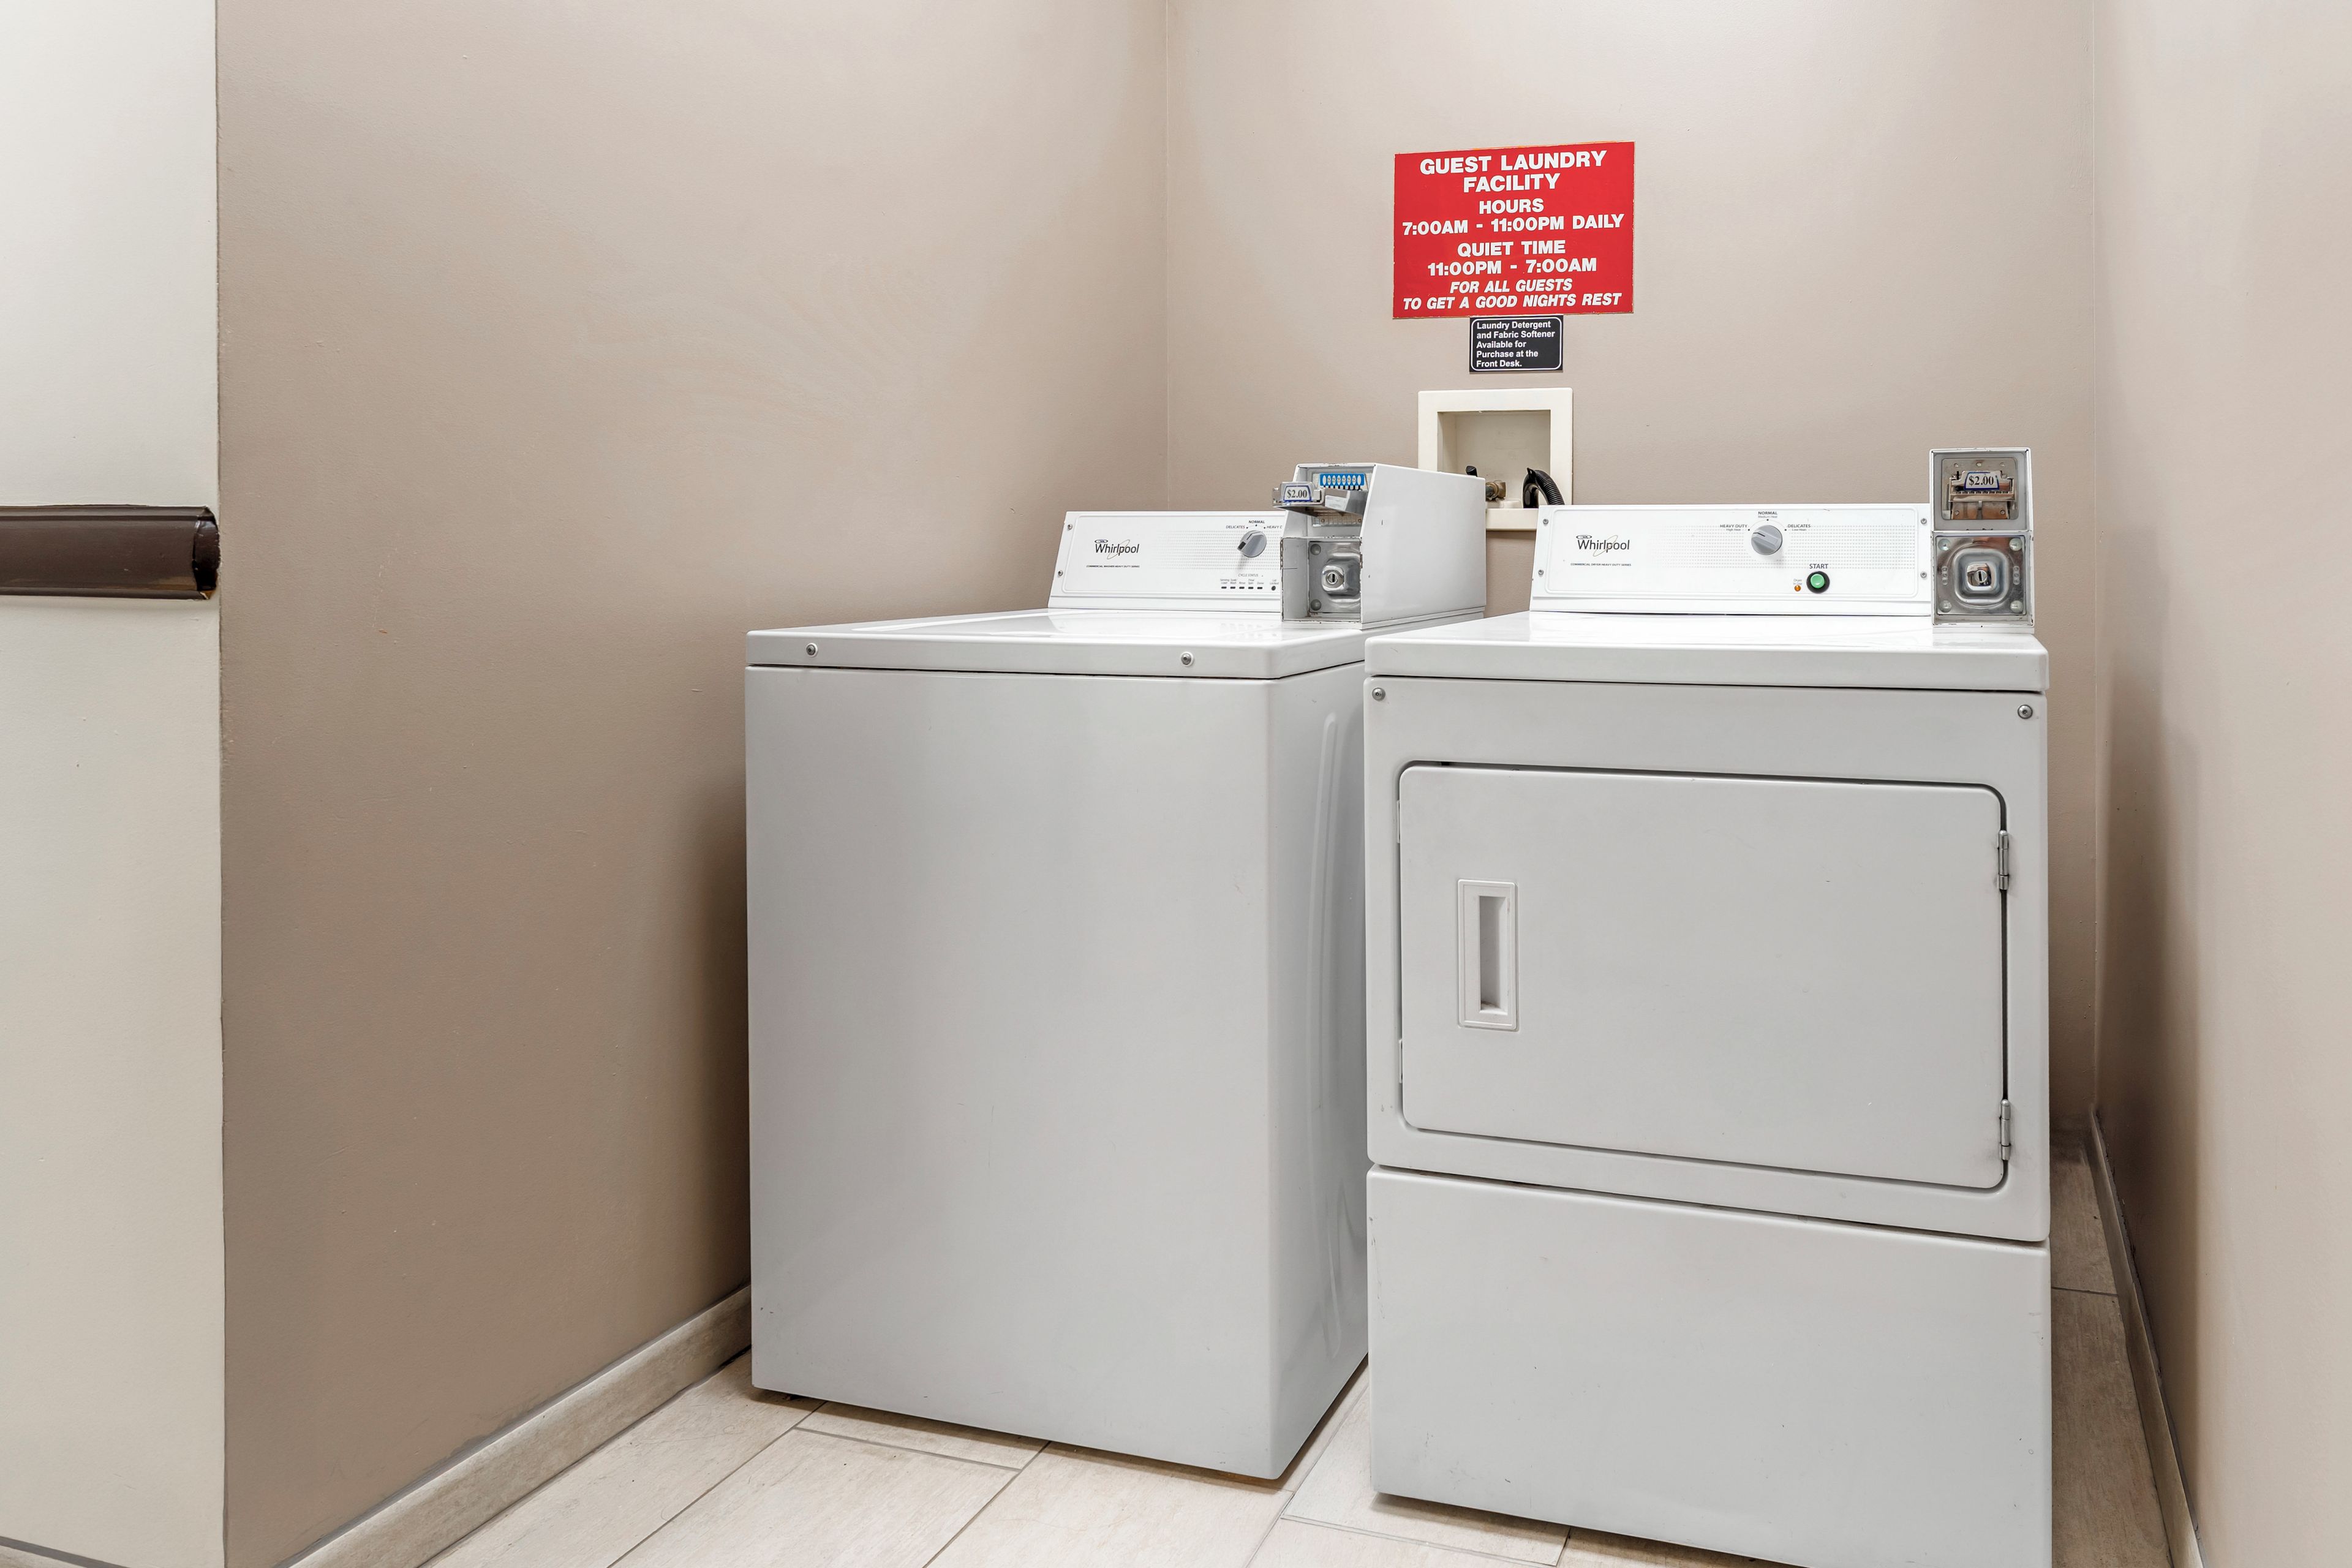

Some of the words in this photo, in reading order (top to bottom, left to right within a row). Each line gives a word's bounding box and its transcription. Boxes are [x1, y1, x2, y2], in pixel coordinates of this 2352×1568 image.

[1420, 156, 1492, 175] GUEST
[1501, 150, 1607, 171] LAUNDRY
[1463, 173, 1561, 193] FACILITY
[1479, 198, 1544, 214] HOURS
[1402, 219, 1468, 236] 7:00AM
[1491, 216, 1564, 232] 11:00PM
[1572, 214, 1625, 230] DAILY
[1457, 241, 1514, 258] QUIET
[1521, 239, 1566, 255] TIME
[1427, 260, 1502, 276] 11:00PM
[1526, 257, 1597, 273] 7:00AM
[1450, 281, 1480, 294] FOR
[1484, 280, 1510, 293] ALL
[1515, 278, 1573, 292] GUESTS
[1403, 297, 1422, 310] TO
[1427, 296, 1455, 309] GET
[1459, 296, 1469, 309] A
[1476, 295, 1518, 309] GOOD
[1523, 293, 1577, 307] NIGHTS
[1581, 293, 1622, 306] REST
[1477, 322, 1510, 331] Laundry
[1512, 321, 1551, 330] Detergent
[1476, 350, 1513, 358] Purchase
[1968, 476, 1994, 486] $2.00
[1287, 489, 1308, 499] $2.00
[1095, 543, 1140, 556] Whirlpool
[1577, 540, 1630, 553] Whirlpool
